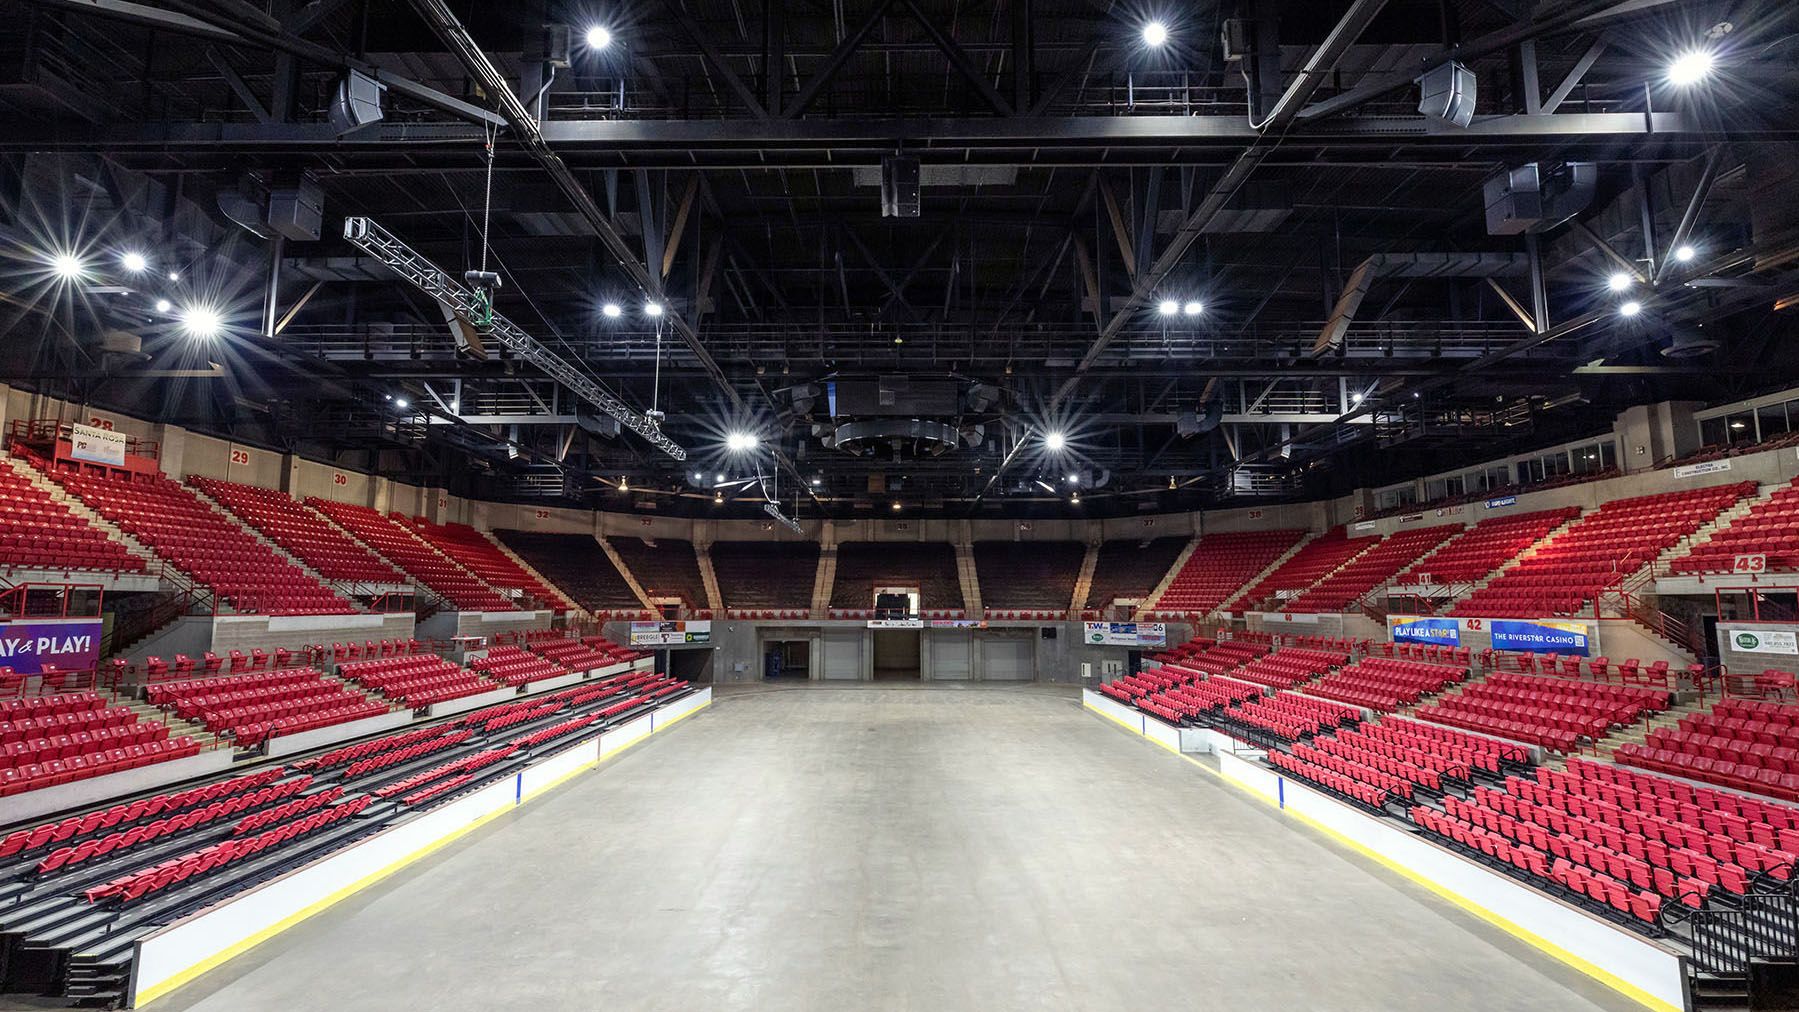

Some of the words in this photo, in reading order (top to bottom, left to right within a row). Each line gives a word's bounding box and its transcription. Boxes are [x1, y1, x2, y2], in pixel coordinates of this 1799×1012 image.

[90, 417, 113, 432] 28
[74, 427, 101, 440] SANTA
[232, 450, 248, 464] 29
[334, 473, 347, 486] 30
[439, 498, 447, 508] 31
[536, 510, 550, 519] 32
[1735, 556, 1764, 571] 43
[1395, 626, 1411, 637] PLAY
[1411, 627, 1424, 637] LIKE
[1424, 628, 1431, 637] A
[1467, 619, 1482, 631] 42
[1494, 632, 1507, 641] THE
[1508, 633, 1545, 643] RIVERSTAR
[1545, 635, 1574, 645] CASINO
[36, 635, 91, 656] PLAY!
[1677, 671, 1690, 680] 12
